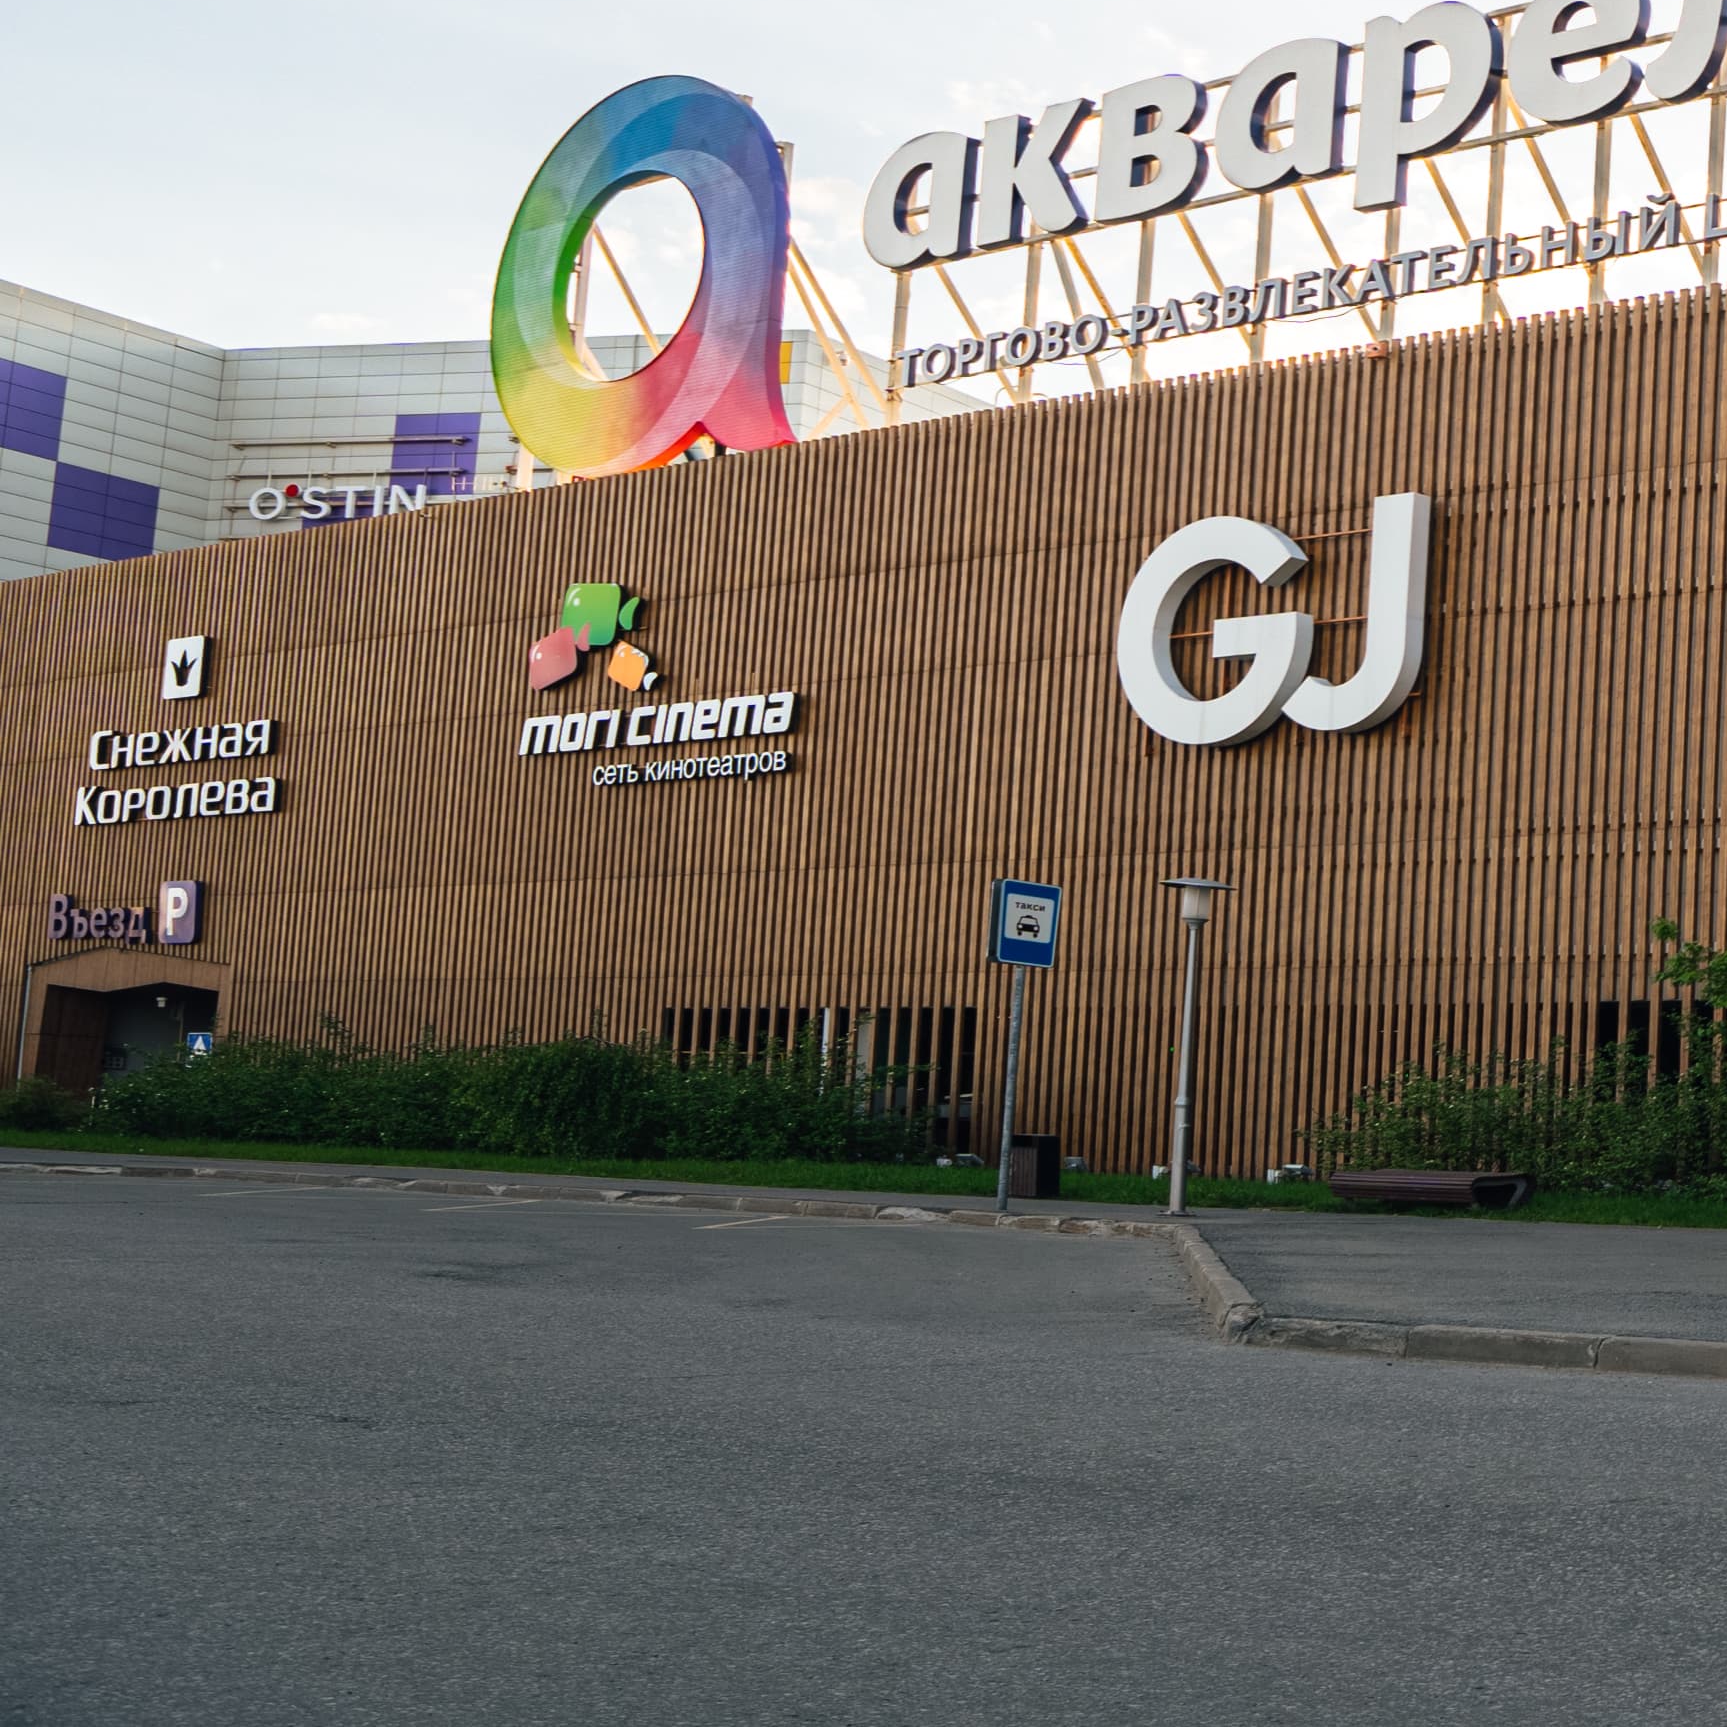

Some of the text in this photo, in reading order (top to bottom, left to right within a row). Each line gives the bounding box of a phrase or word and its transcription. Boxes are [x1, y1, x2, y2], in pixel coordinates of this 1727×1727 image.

[896, 192, 1681, 388] ТОРГОВО-РАЗВЛЕКАТЕЛЬНЫЙ
[1117, 492, 1432, 747] GJ
[89, 719, 271, 771] Снежная
[518, 691, 795, 756] mori cinema
[593, 749, 788, 786] сеть кинотеатров
[74, 776, 276, 826] Королева
[49, 892, 148, 945] Въезд
